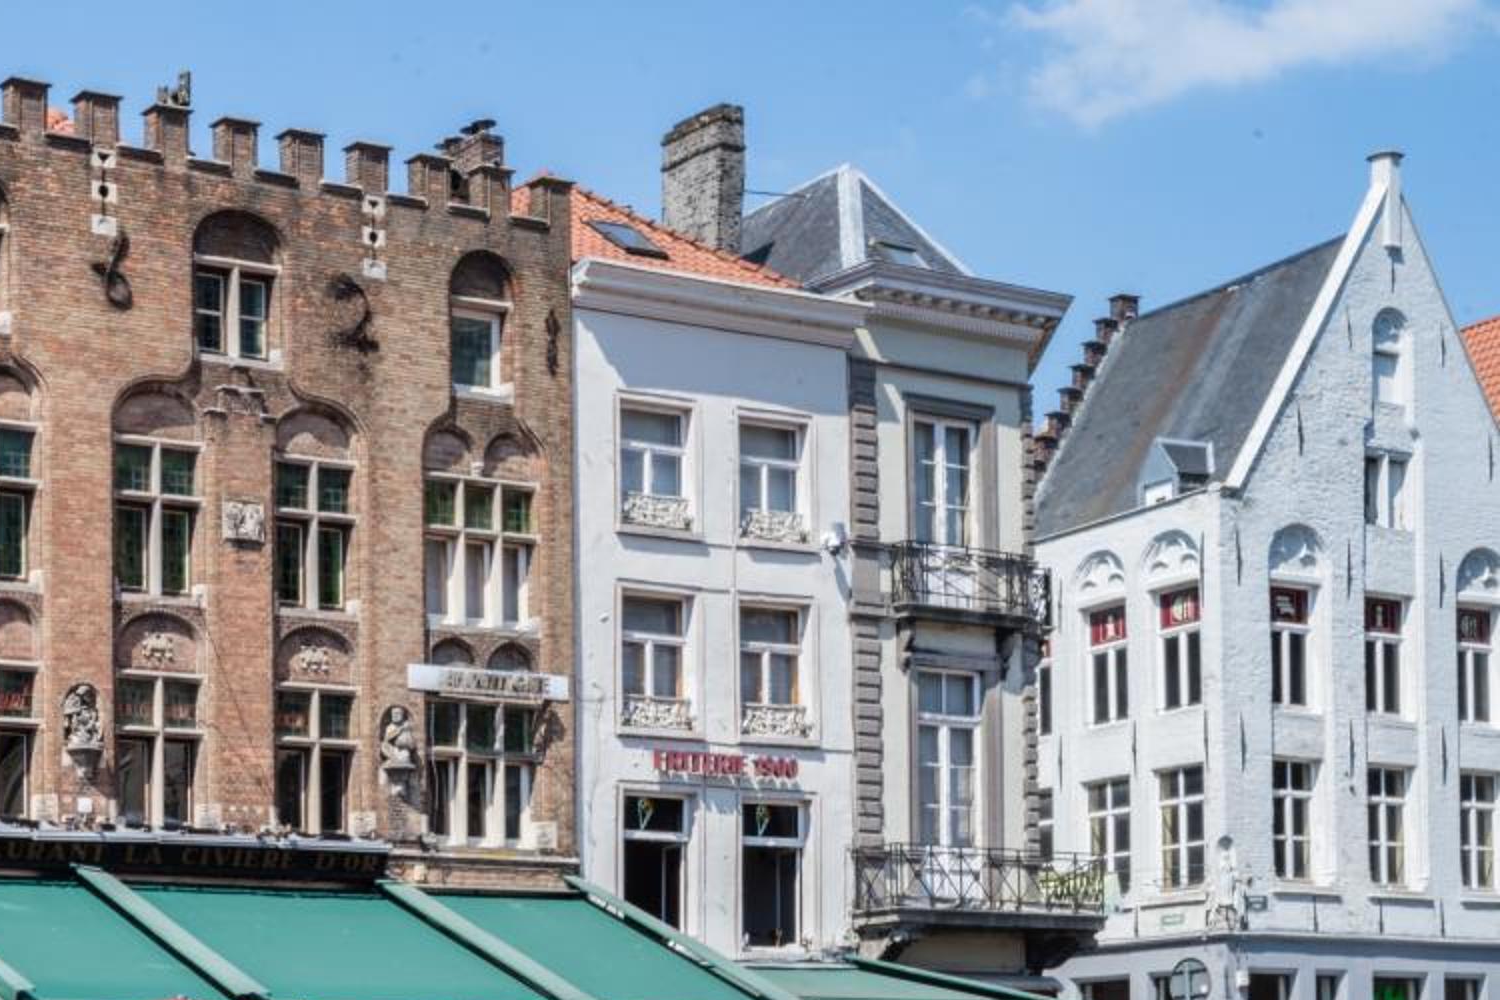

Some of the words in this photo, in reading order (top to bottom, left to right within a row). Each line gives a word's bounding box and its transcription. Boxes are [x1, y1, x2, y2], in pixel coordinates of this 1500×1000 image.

[653, 750, 748, 776] FRITERIE
[753, 755, 799, 779] 1900
[124, 844, 162, 864] LA
[314, 852, 382, 875] D'OR
